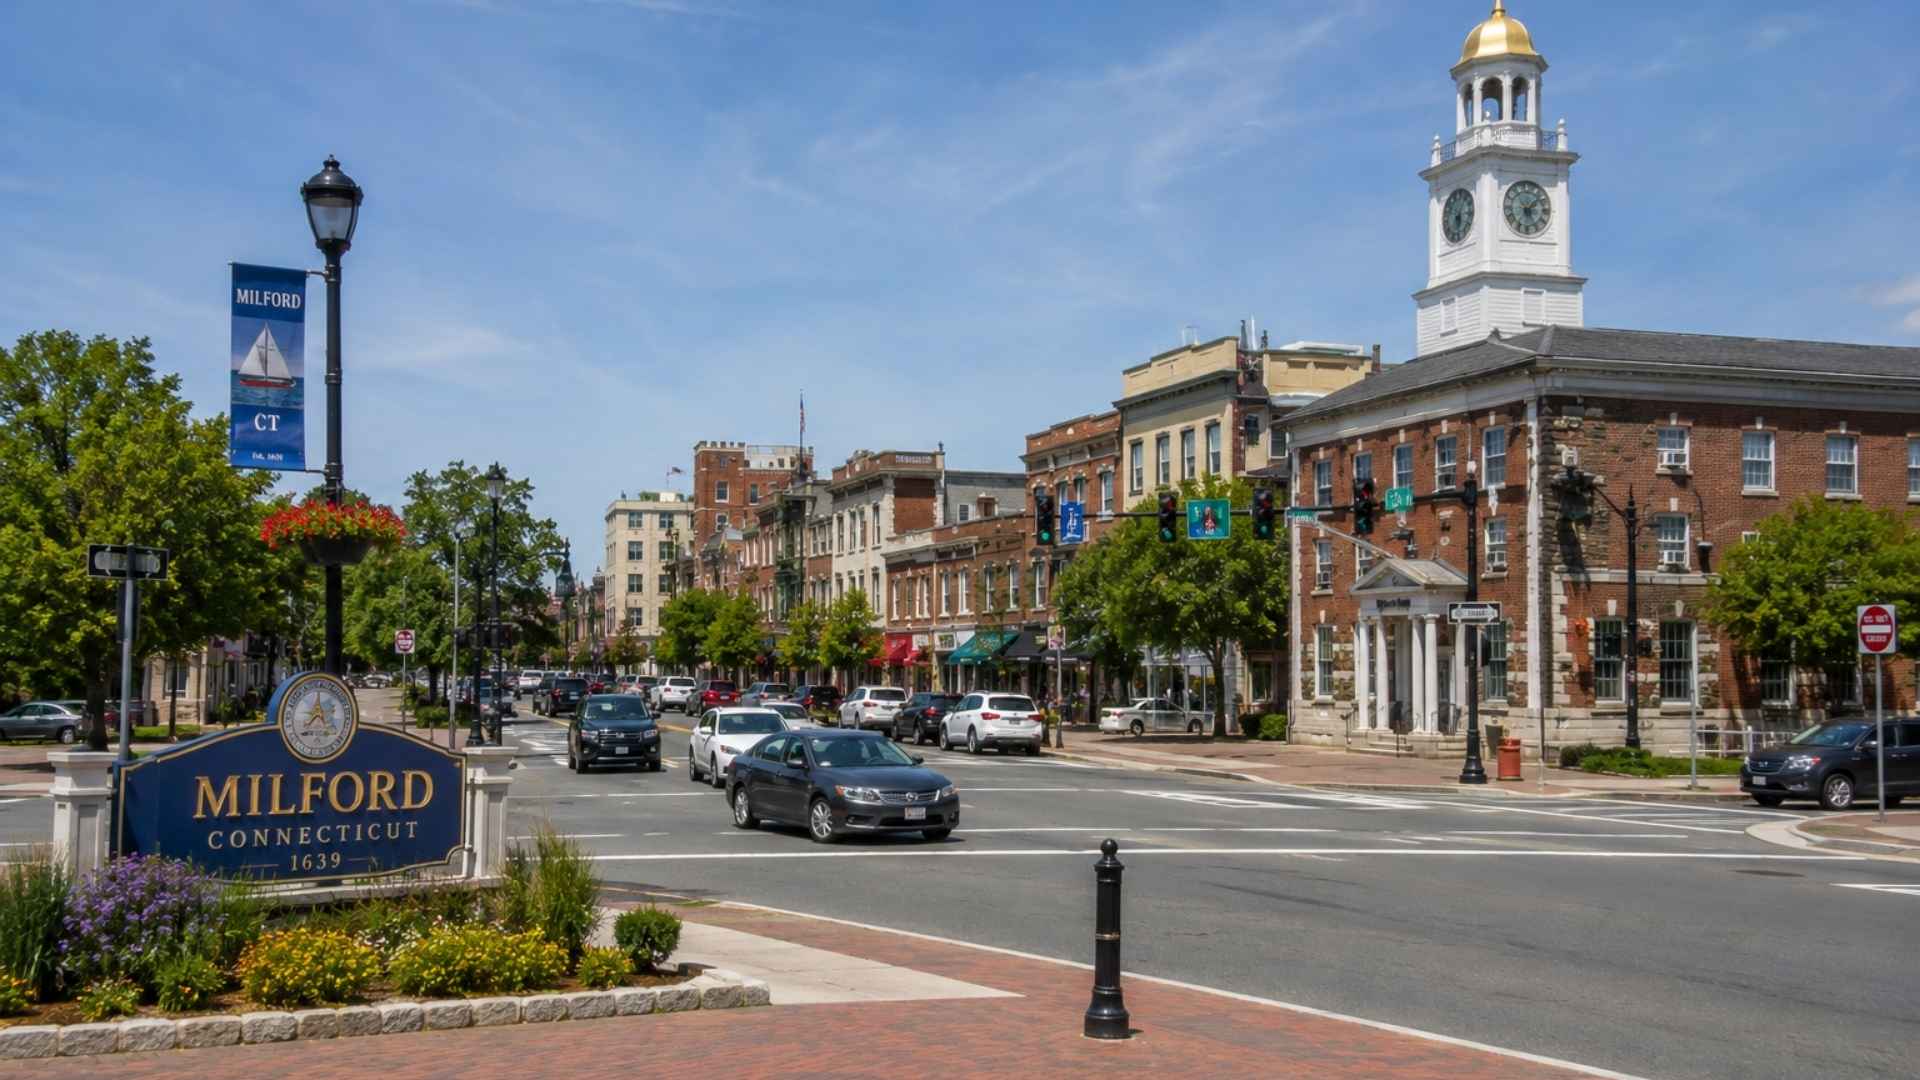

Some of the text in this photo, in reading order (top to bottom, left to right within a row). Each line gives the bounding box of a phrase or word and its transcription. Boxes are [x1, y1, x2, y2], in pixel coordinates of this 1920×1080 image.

[236, 288, 301, 309] MILFORD
[254, 412, 280, 431] CT
[193, 770, 433, 818] MILFORD
[207, 821, 419, 849] CONNECTICUT
[290, 852, 342, 871] 1639
